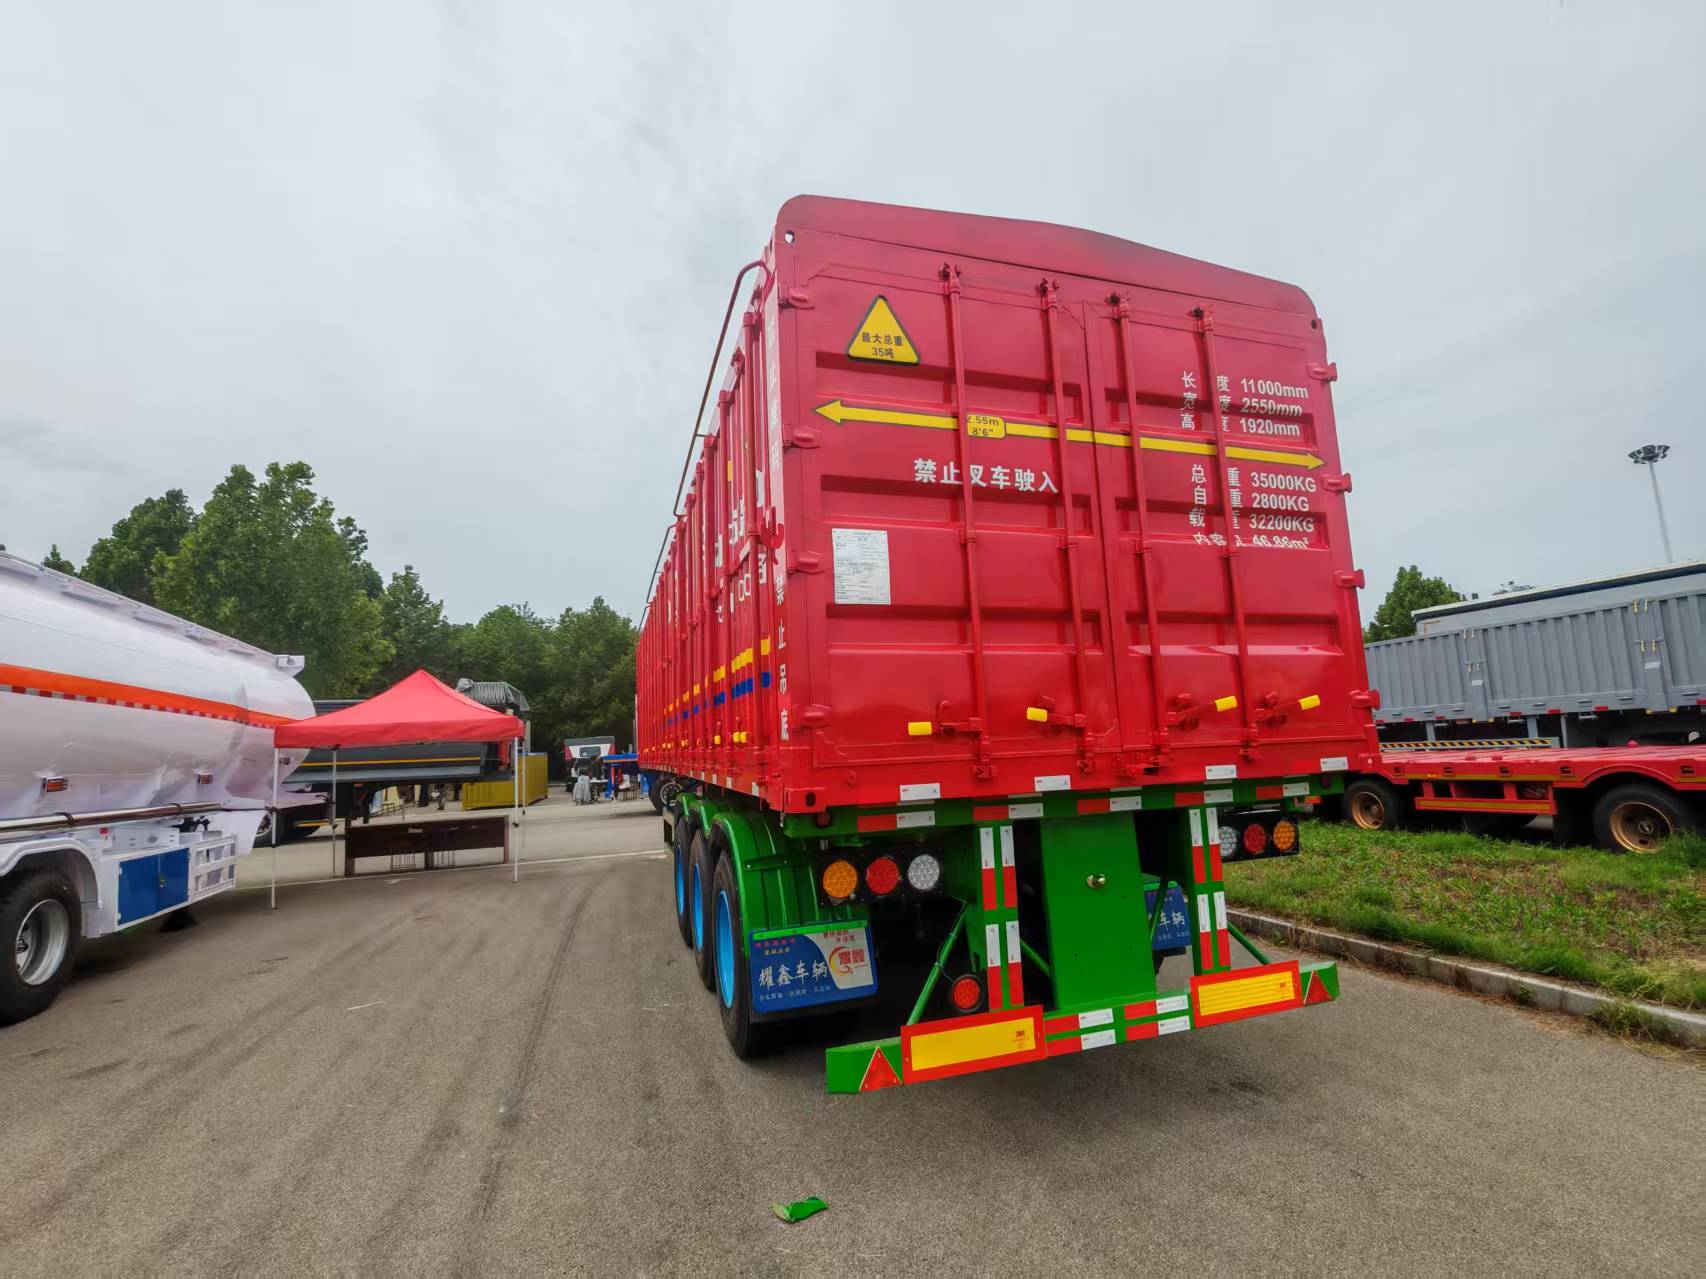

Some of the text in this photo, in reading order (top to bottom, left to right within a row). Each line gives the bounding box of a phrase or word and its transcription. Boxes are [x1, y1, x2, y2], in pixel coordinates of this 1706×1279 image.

[861, 331, 904, 347] 最大总重
[871, 346, 895, 359] 35吨
[1240, 378, 1309, 399] 11000mm
[1240, 397, 1303, 417] 2550mm
[1239, 417, 1300, 437] 1920mm
[913, 457, 1059, 494] 禁止叉车驶入
[1250, 471, 1317, 493] 35000KG
[1251, 492, 1310, 512] 2800KG
[1249, 513, 1314, 533] 32200KG
